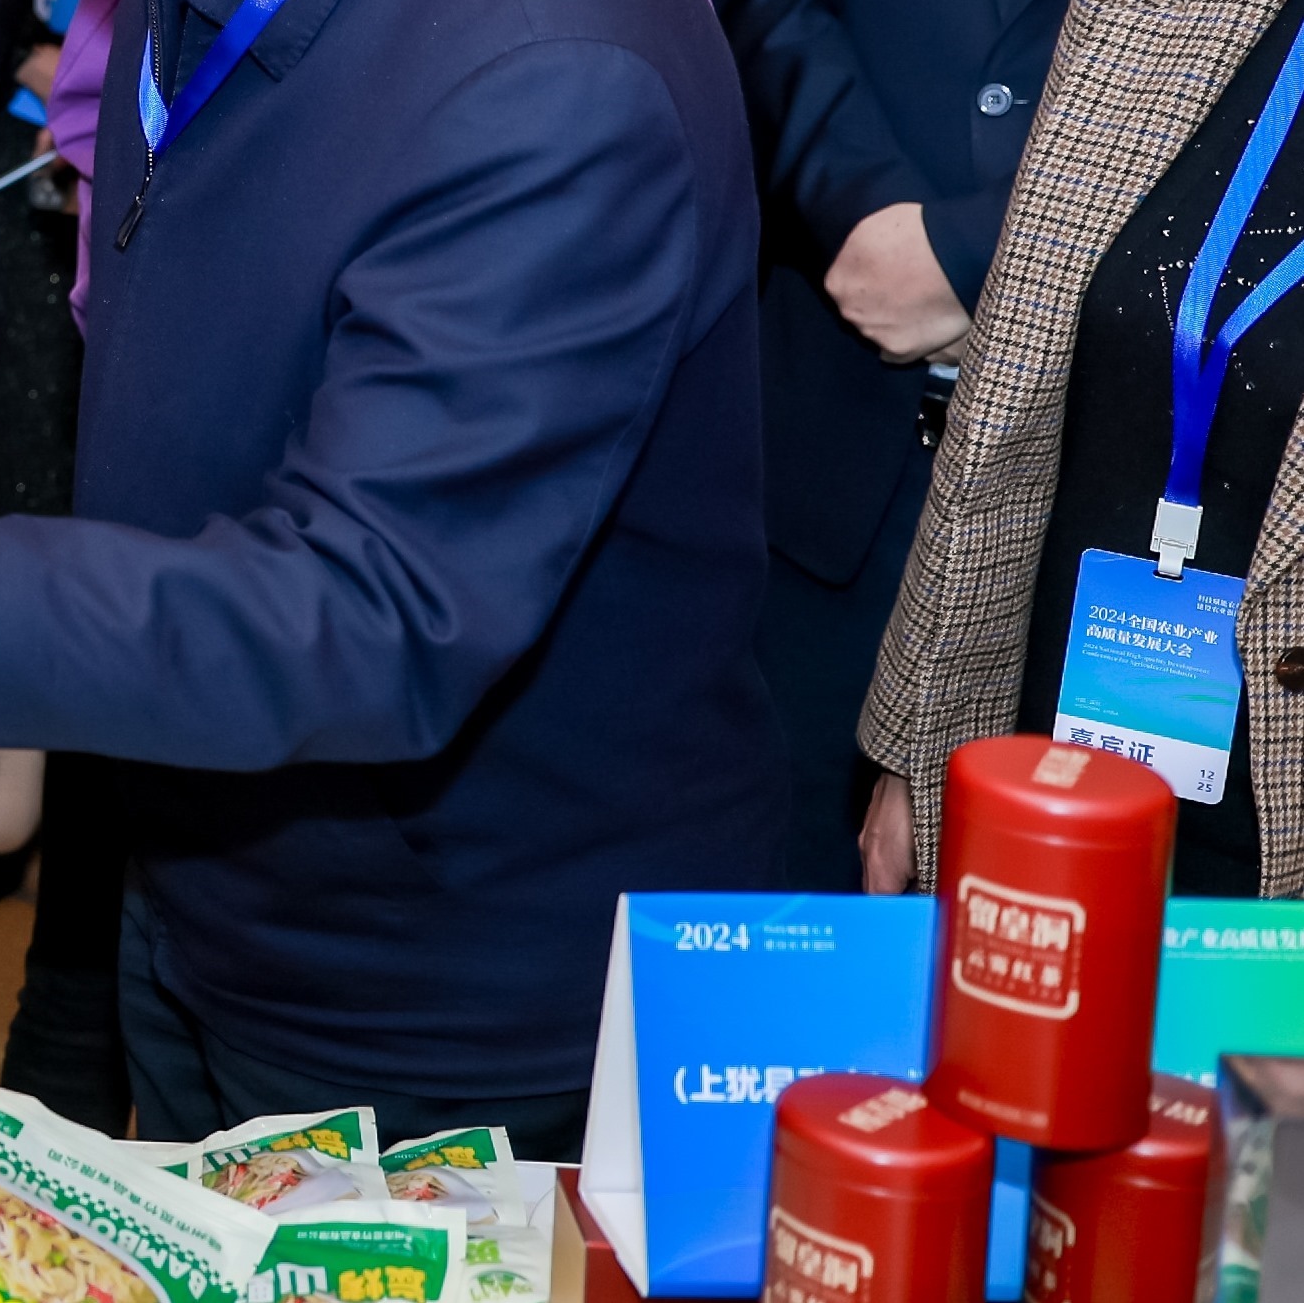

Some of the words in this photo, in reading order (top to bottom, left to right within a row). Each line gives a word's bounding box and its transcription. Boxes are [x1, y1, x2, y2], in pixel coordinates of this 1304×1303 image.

[1088, 605, 1219, 645] 2024全国农业产业
[1086, 624, 1194, 658] 高质量发展大会
[1197, 782, 1213, 793] 25
[1199, 769, 1215, 780] 12
[675, 922, 750, 951] 2024
[61, 1203, 209, 1300] BAMBOO
